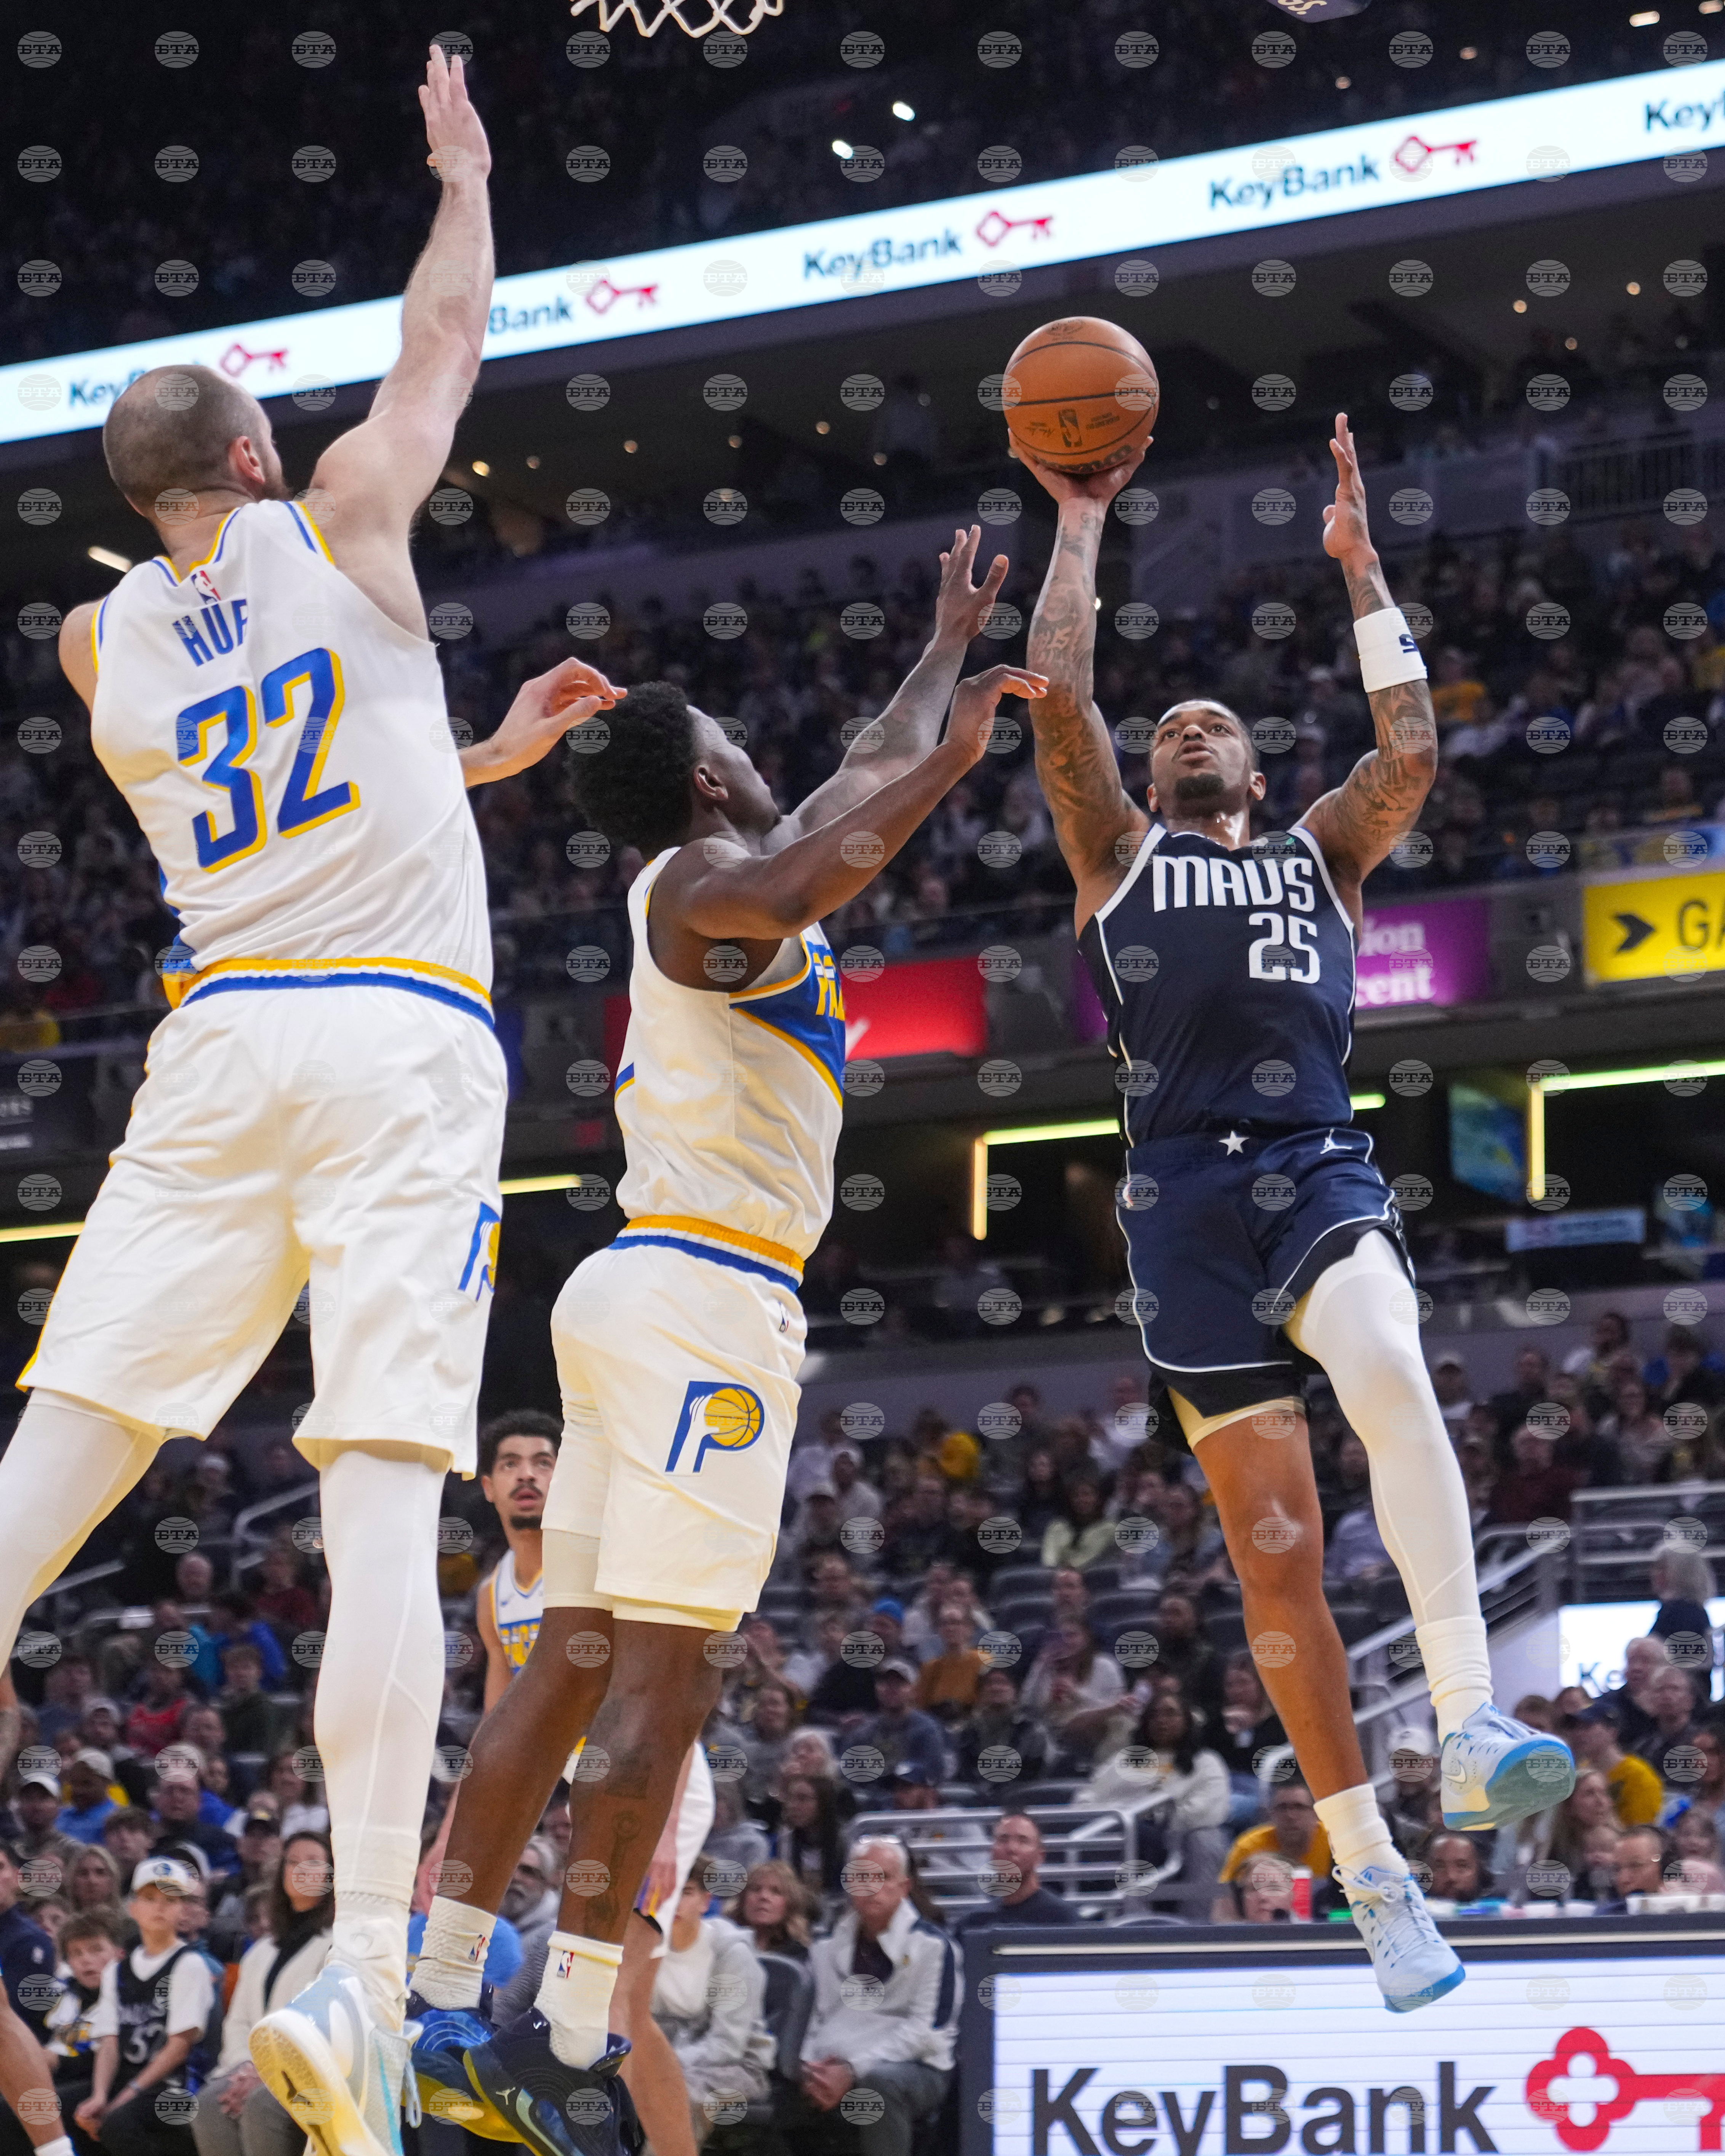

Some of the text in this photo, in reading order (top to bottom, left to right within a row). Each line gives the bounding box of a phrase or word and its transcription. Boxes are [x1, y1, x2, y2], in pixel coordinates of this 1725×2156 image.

[1210, 153, 1379, 209] KeyBank
[804, 227, 962, 281] KeyBank
[175, 647, 361, 873] 32
[1152, 855, 1315, 912] MAVS
[1248, 912, 1320, 984] 25
[1677, 898, 1725, 950] G
[1031, 2061, 1500, 2156] KeyBank
